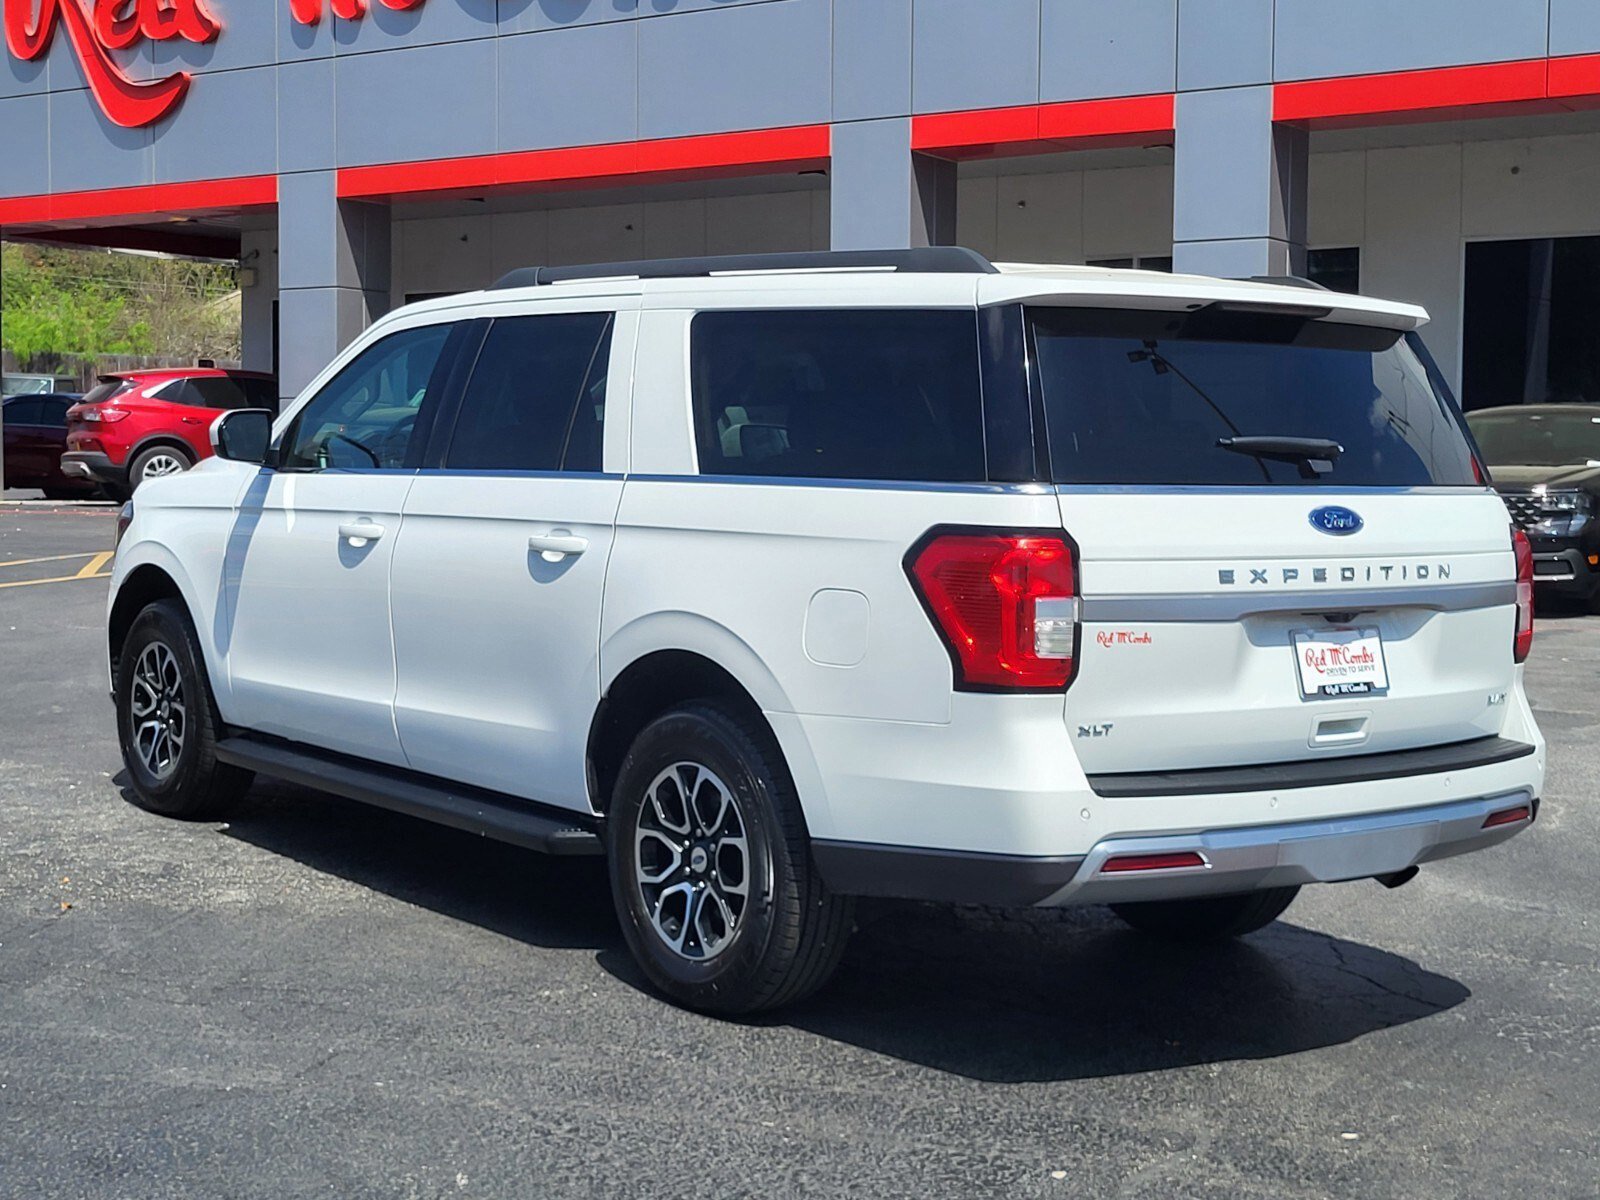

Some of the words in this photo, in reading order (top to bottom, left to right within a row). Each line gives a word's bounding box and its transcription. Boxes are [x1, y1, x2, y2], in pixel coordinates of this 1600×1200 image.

[1324, 511, 1355, 528] Ford
[1219, 564, 1450, 584] EXPEDITION
[1097, 631, 1114, 648] Red
[1305, 647, 1327, 673] Red
[1326, 667, 1347, 676] DRIVEN
[1358, 664, 1375, 672] SERVE
[1077, 723, 1114, 738] XLT
